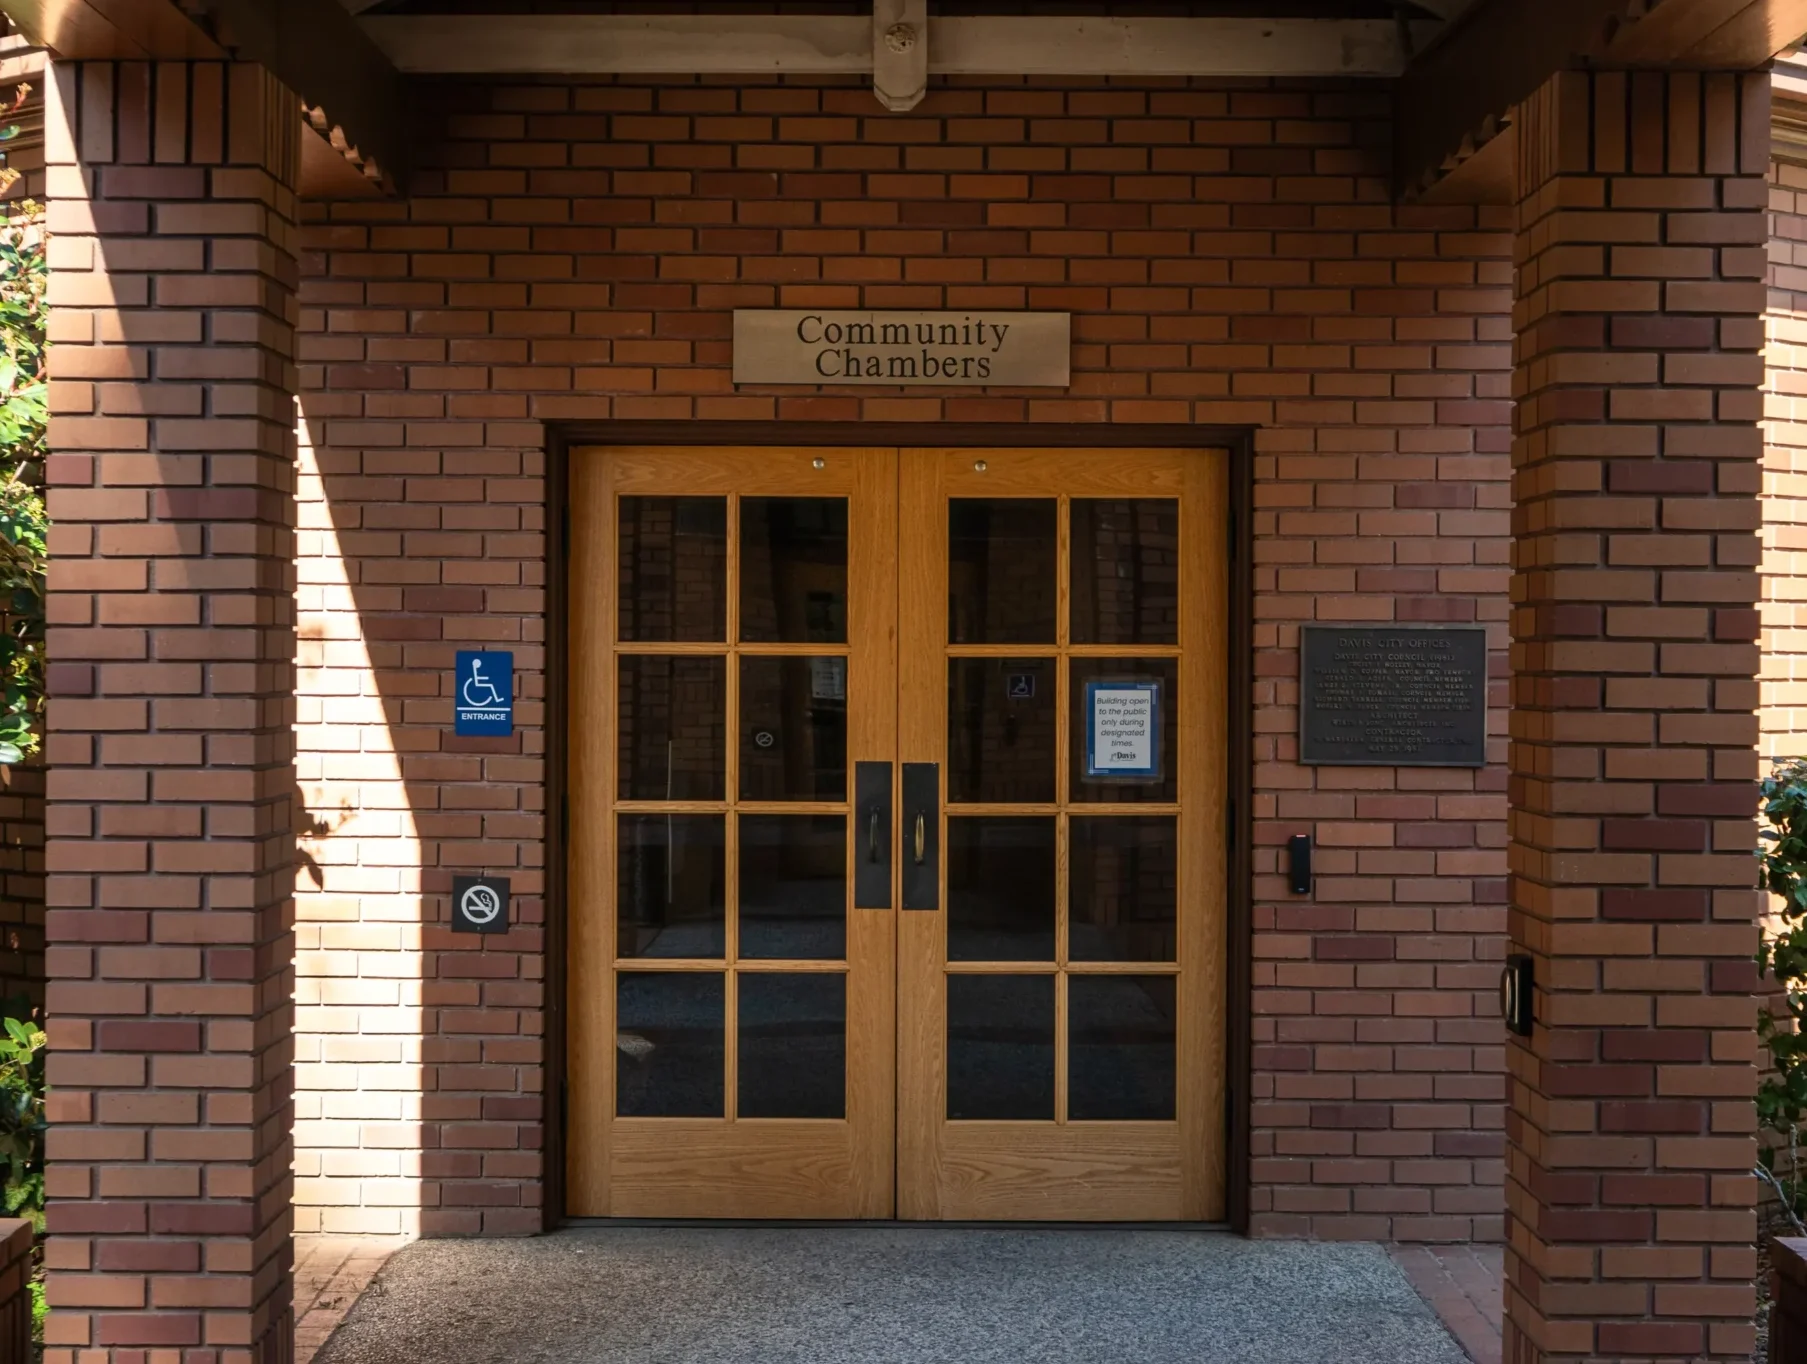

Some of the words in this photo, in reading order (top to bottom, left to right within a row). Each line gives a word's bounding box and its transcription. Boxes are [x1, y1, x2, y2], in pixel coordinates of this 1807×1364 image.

[797, 316, 1009, 352] Community
[816, 349, 990, 378] Chambers
[1338, 638, 1372, 648] DAVIS
[1378, 638, 1404, 648] CITY
[1409, 638, 1451, 648] OFFICES
[1097, 698, 1127, 706] Building
[1123, 708, 1147, 716] public
[1101, 719, 1116, 727] only
[1120, 719, 1144, 727] during
[1101, 730, 1145, 738] designated
